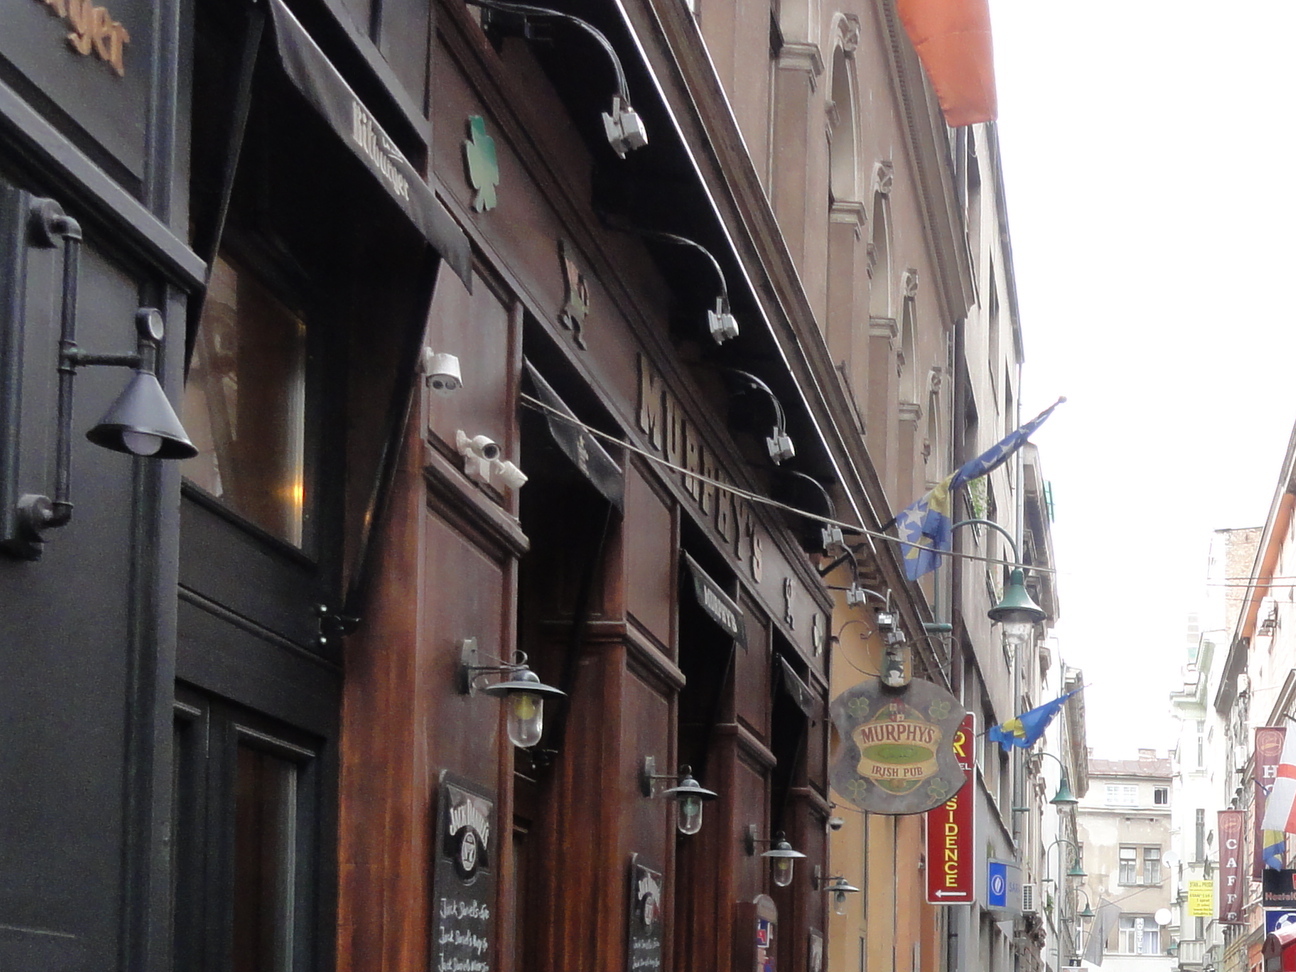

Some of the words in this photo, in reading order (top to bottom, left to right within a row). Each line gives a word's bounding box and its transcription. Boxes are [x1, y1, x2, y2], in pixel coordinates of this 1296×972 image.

[861, 723, 935, 744] MURPHYS
[871, 764, 898, 777] IRISH
[903, 766, 923, 776] PUB
[944, 797, 958, 887] SIDENCE
[1226, 838, 1238, 921] CAFFE
